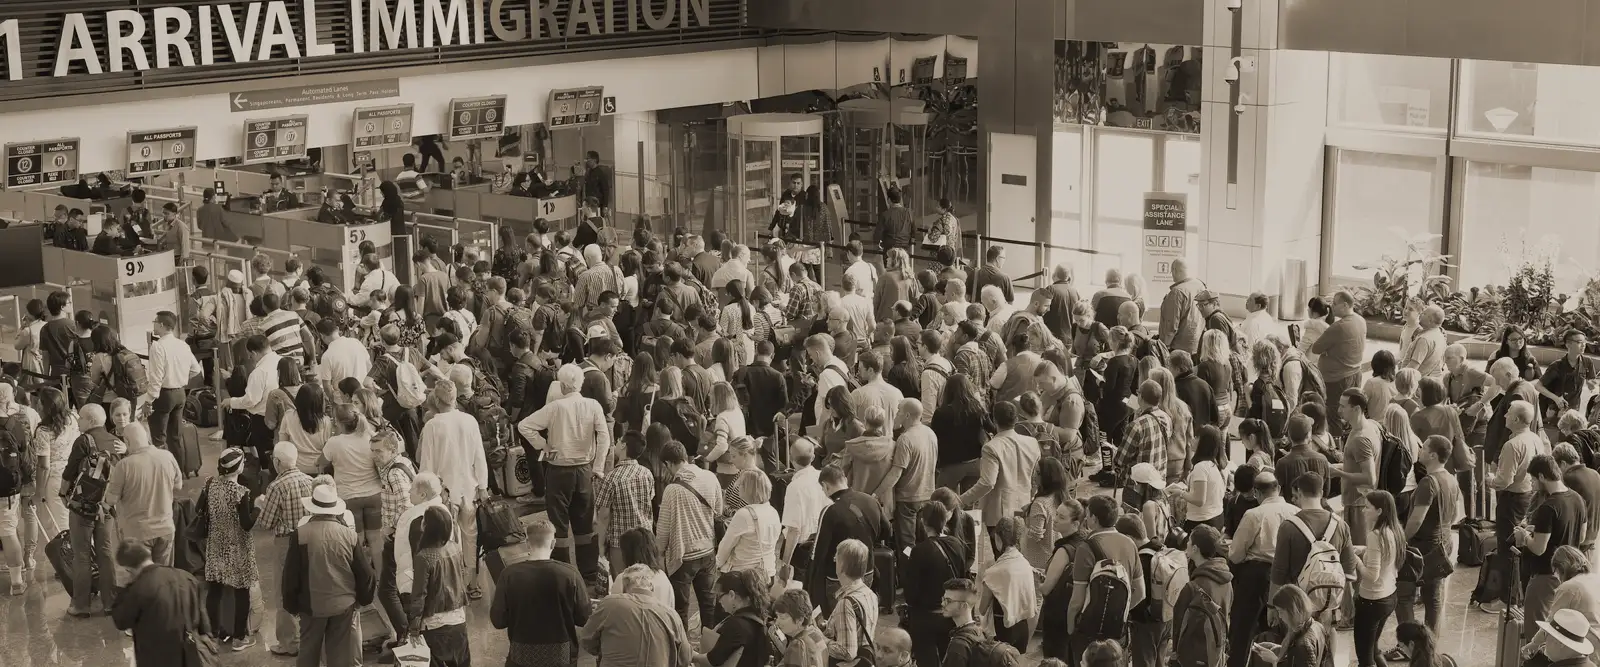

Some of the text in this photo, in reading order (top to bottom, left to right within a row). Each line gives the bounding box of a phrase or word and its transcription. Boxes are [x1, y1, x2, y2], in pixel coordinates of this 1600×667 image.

[54, 0, 336, 77] ARRIVAL
[302, 86, 332, 95] Automated
[1136, 118, 1150, 128] EXIT
[22, 160, 28, 169] 12
[57, 156, 63, 166] 11
